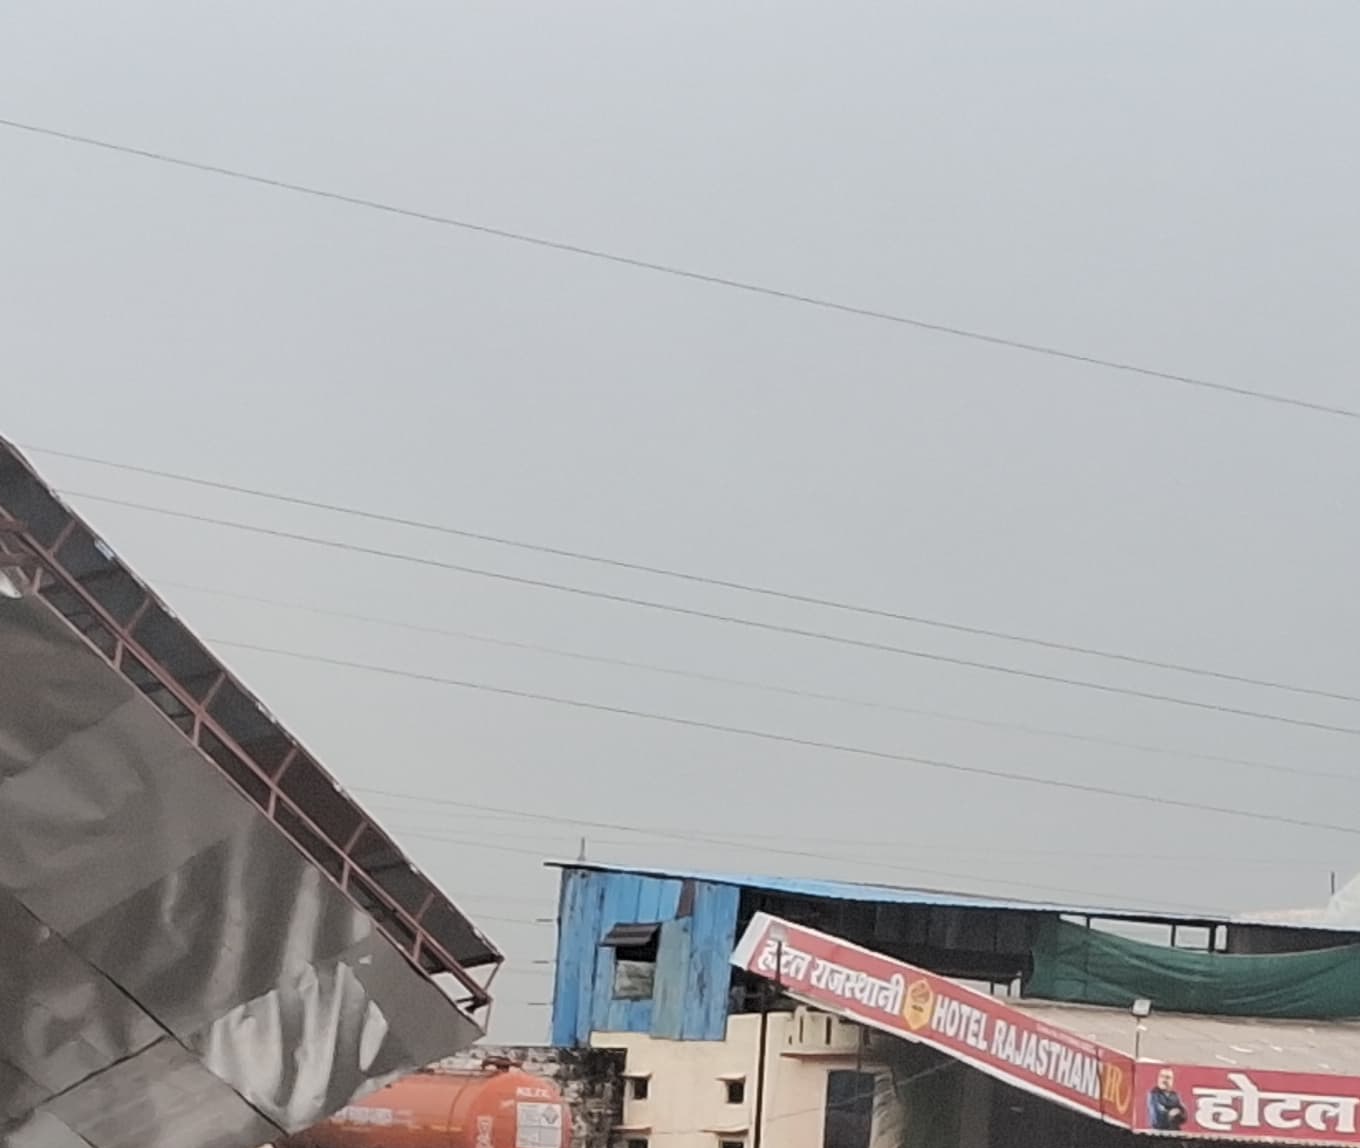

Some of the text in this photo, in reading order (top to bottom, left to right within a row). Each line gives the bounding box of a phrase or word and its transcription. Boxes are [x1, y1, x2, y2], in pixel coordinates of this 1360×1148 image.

[810, 958, 905, 1016] राजस्थानी
[931, 993, 988, 1051] HOTEL
[991, 1018, 1103, 1101] RAJASTHANI
[1191, 1072, 1360, 1134] होटल
